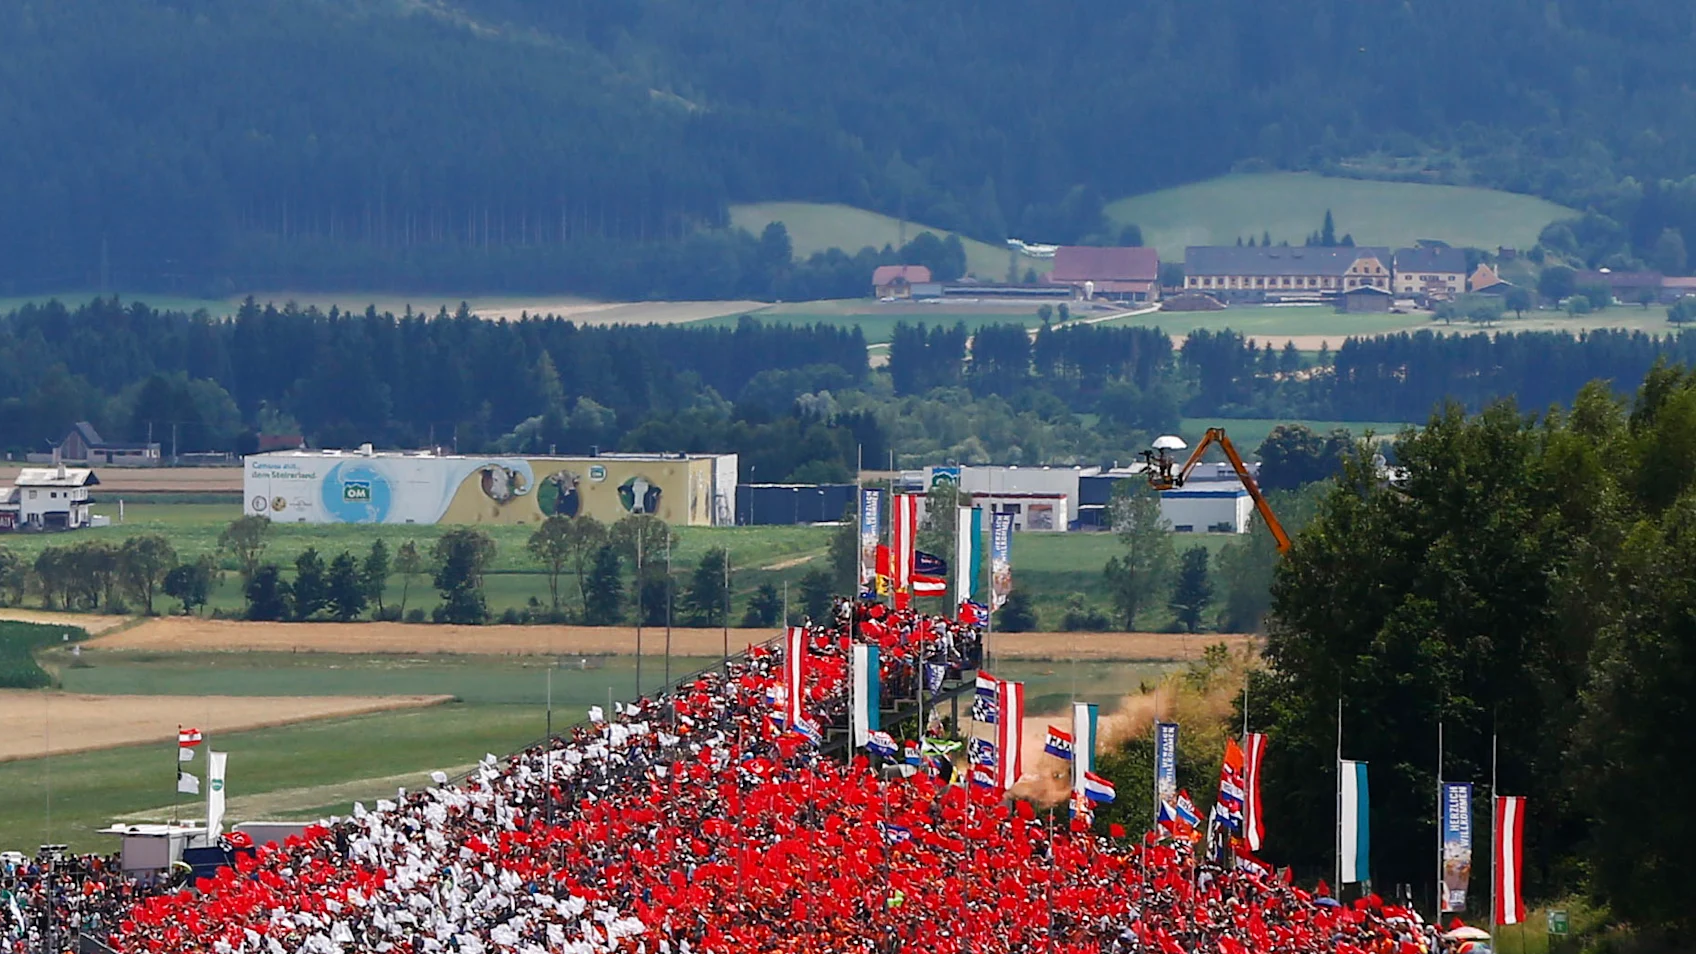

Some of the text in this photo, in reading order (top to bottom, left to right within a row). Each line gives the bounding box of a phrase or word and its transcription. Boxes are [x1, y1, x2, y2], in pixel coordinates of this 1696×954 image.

[347, 488, 366, 498] OM
[1449, 786, 1459, 832] HERZLICH
[1459, 786, 1470, 848] WILLKOMMEN
